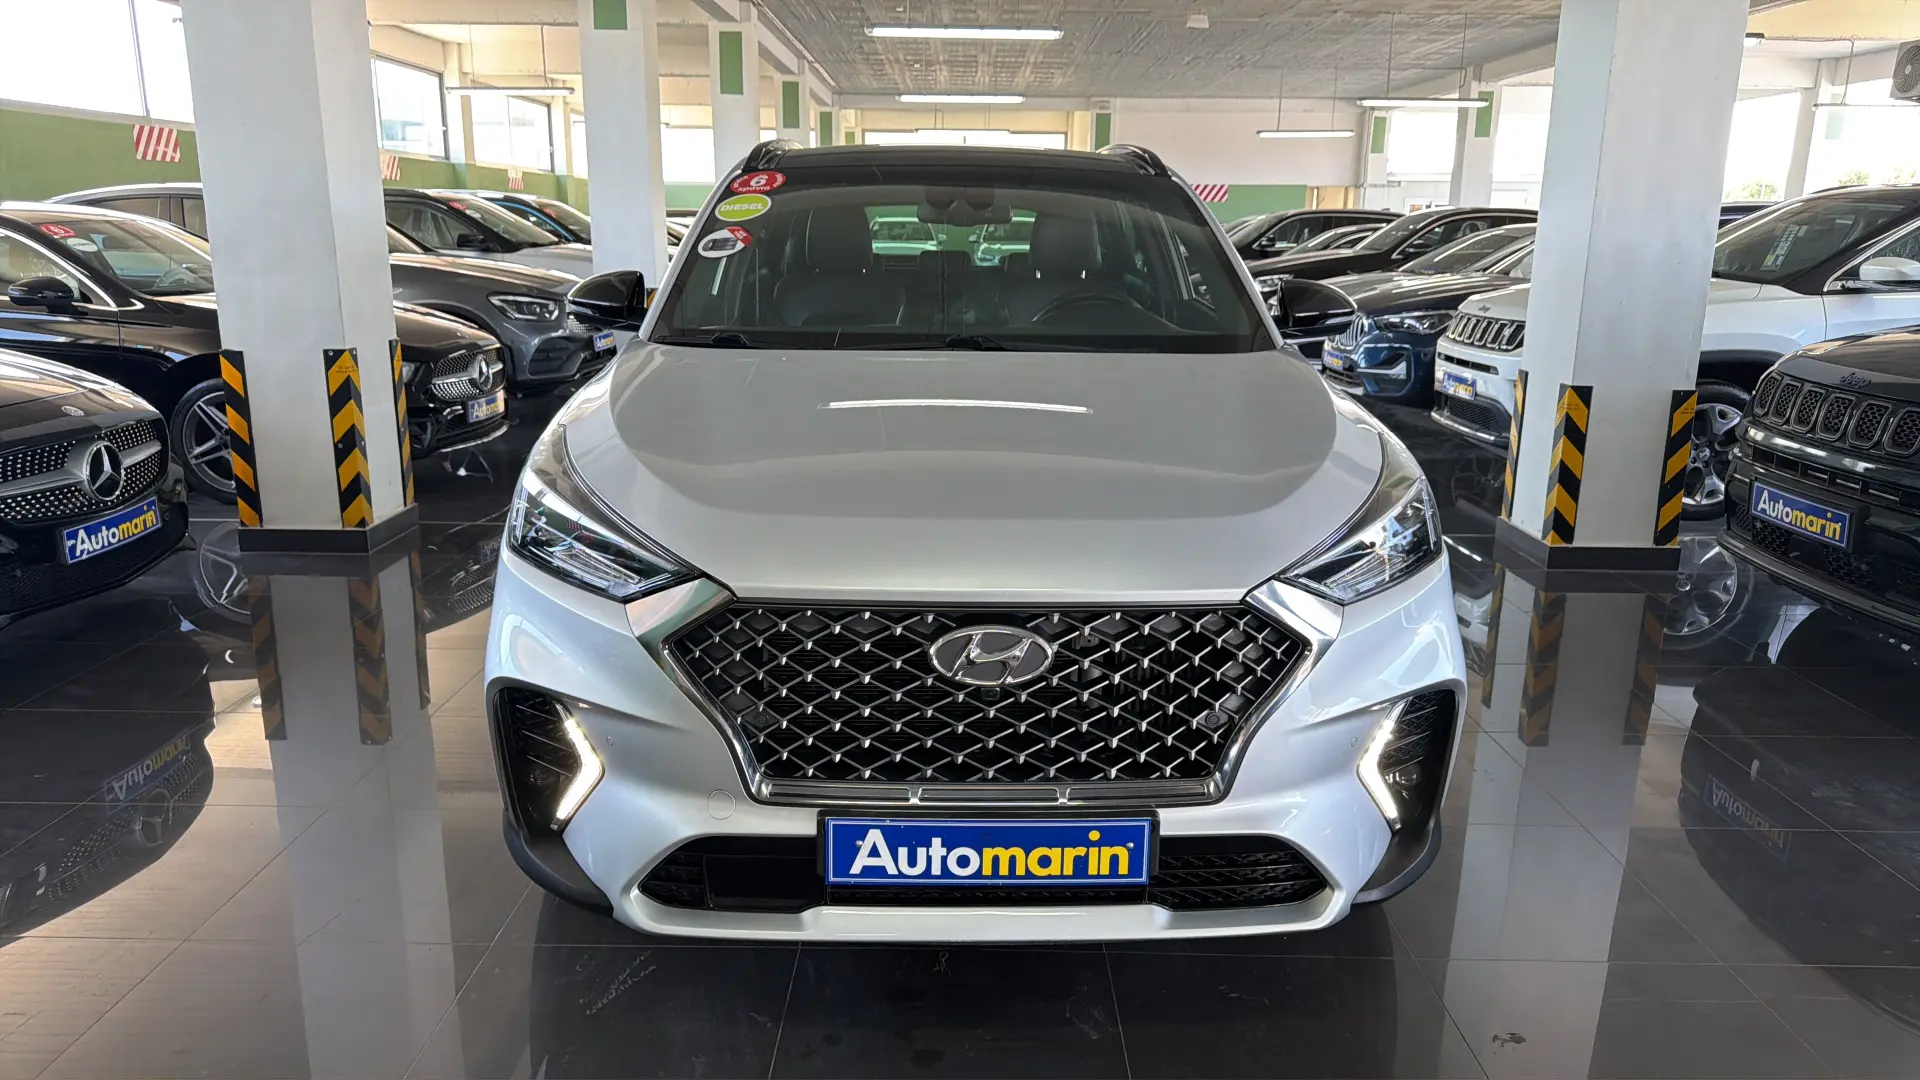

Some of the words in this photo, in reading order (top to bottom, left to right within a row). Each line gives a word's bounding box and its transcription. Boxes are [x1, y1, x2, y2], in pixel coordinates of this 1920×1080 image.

[750, 174, 768, 187] 6
[720, 203, 764, 211] DIESEL
[76, 505, 157, 557] Automarin
[1757, 490, 1841, 540] Automarin
[849, 829, 1129, 876] Automarin
